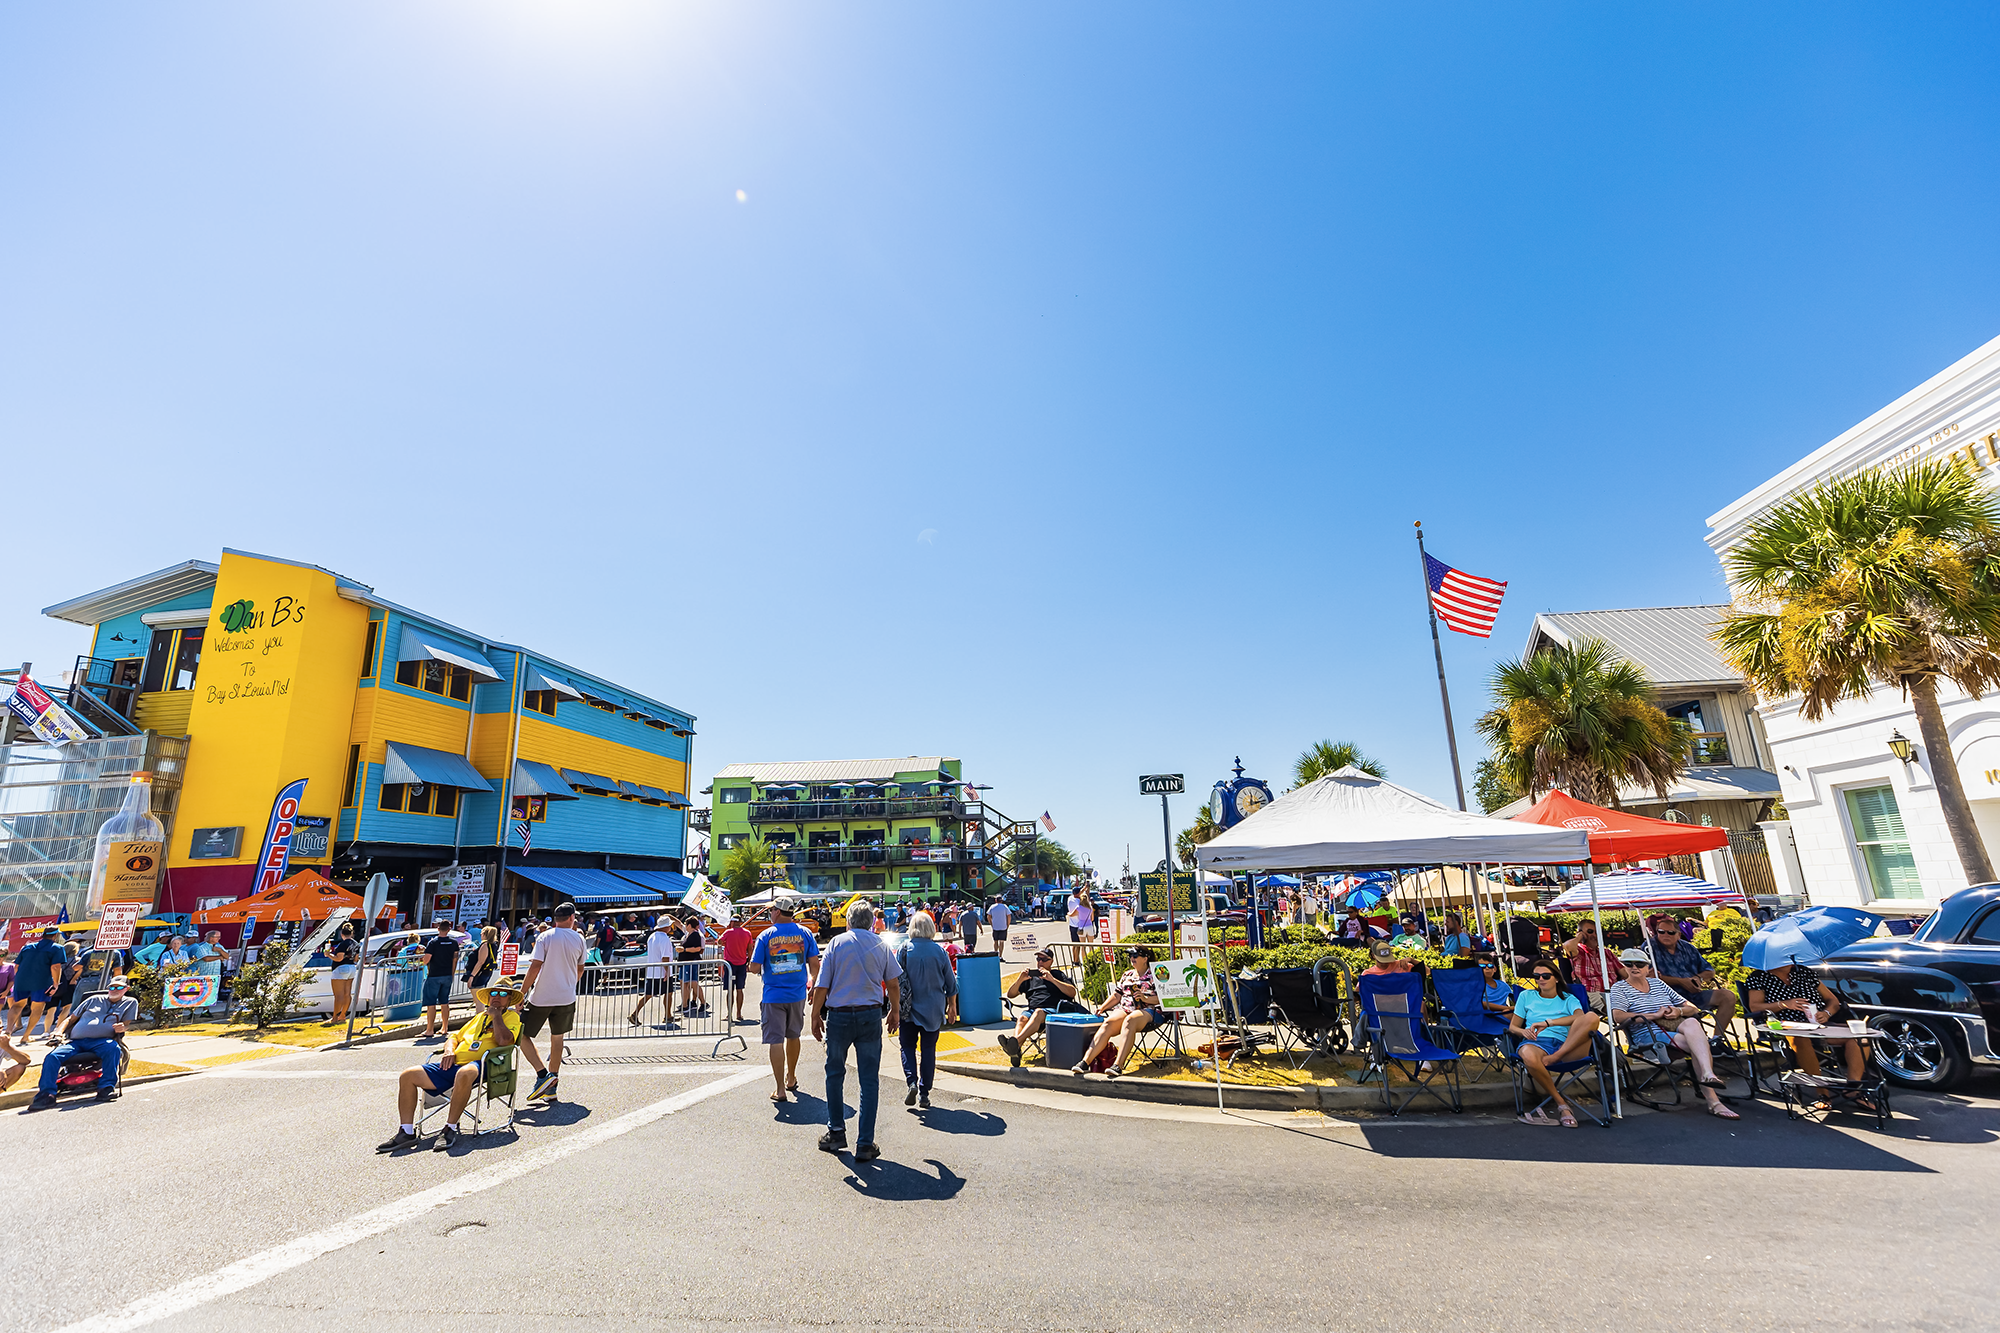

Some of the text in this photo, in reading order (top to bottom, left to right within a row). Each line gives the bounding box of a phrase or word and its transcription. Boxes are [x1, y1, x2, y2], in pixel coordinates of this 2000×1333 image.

[1928, 423, 1959, 445] 1899
[224, 596, 305, 631] Dan B's
[214, 636, 284, 656] Welcomes you
[240, 661, 256, 677] To
[206, 685, 226, 705] Bay
[1146, 780, 1179, 792] MAIN
[123, 843, 158, 854] Tito's
[257, 797, 298, 892] OPEN
[295, 832, 329, 856] Lite
[113, 873, 157, 882] Handmade
[19, 922, 34, 930] This
[1187, 934, 1196, 942] NO
